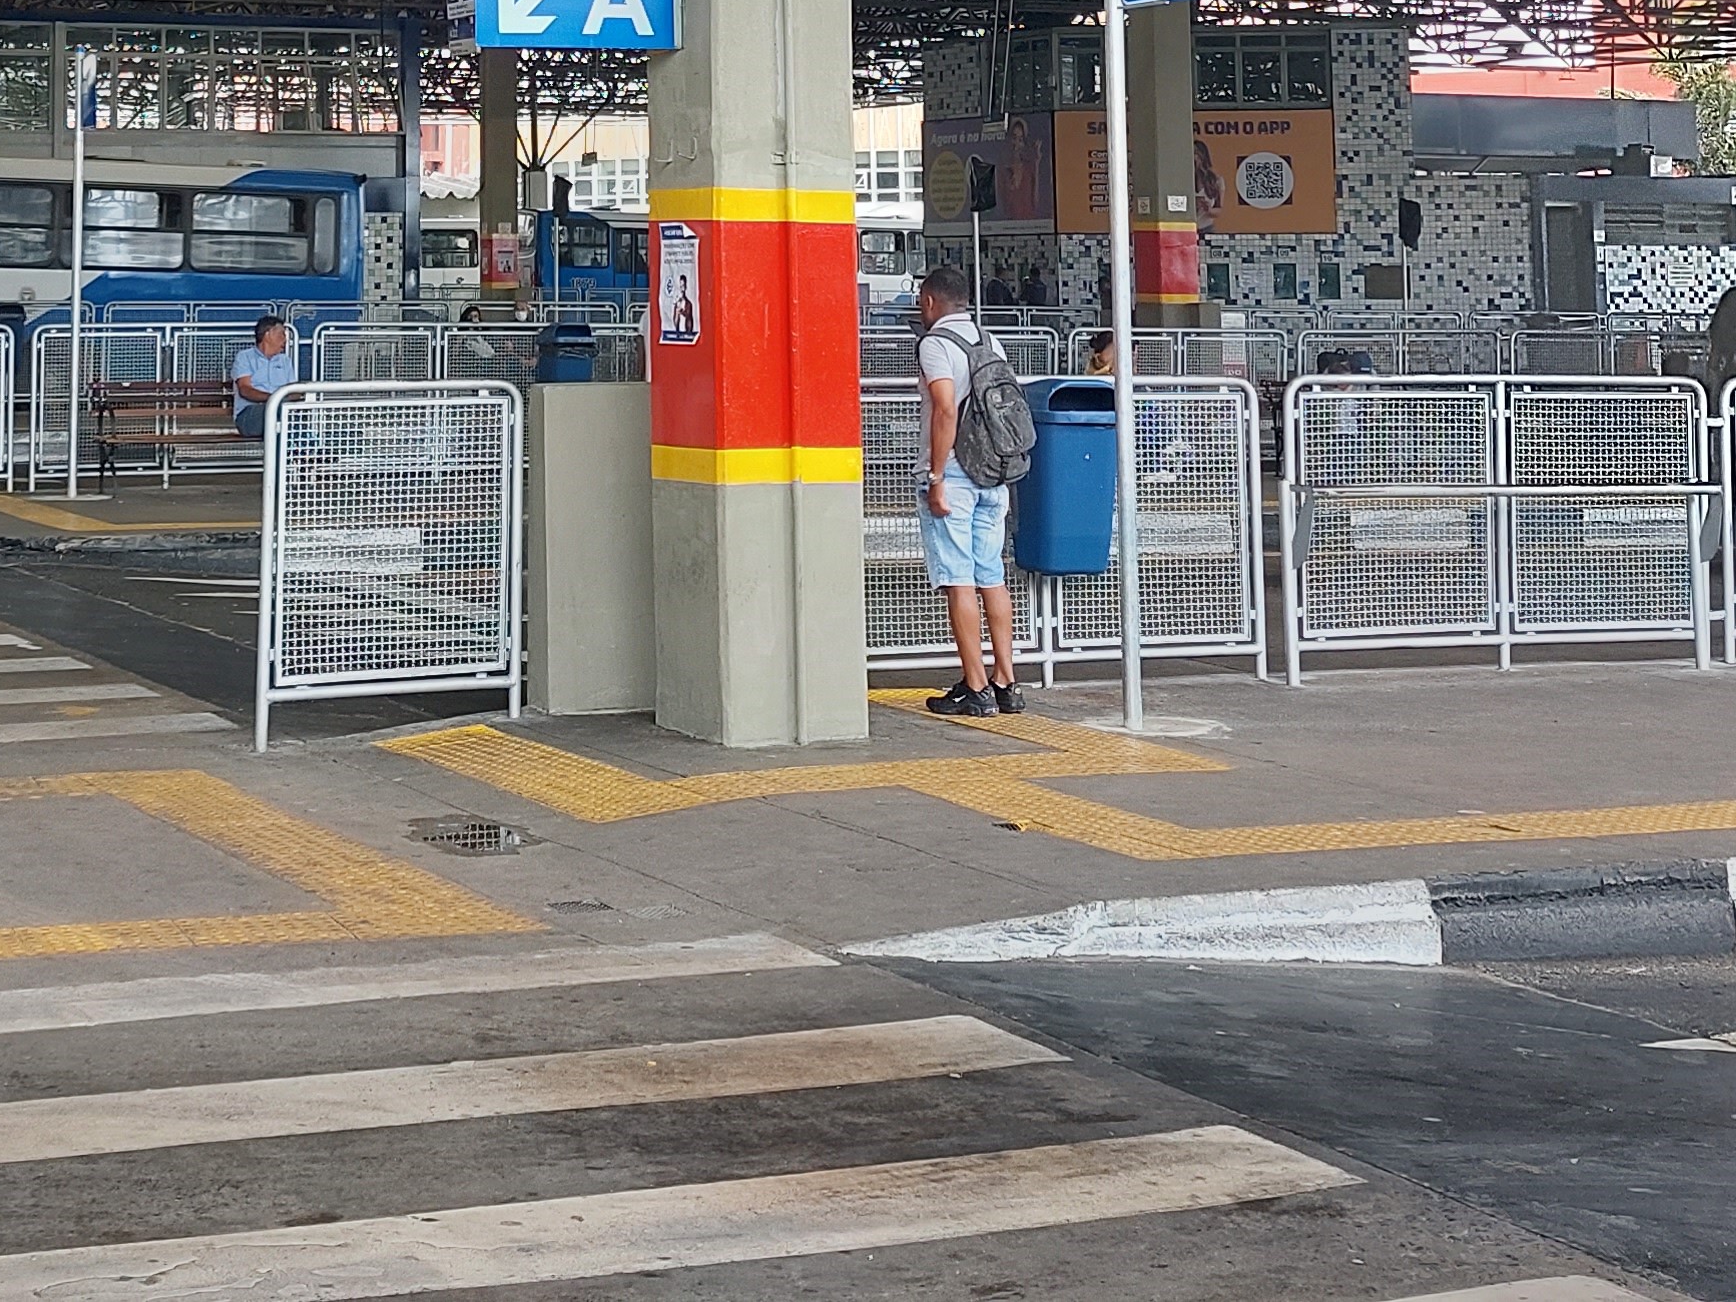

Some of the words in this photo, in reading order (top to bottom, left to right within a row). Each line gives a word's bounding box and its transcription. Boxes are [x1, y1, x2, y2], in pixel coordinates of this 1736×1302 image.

[1204, 121, 1239, 135] COM
[1242, 121, 1254, 135] O
[1257, 121, 1291, 135] APP
